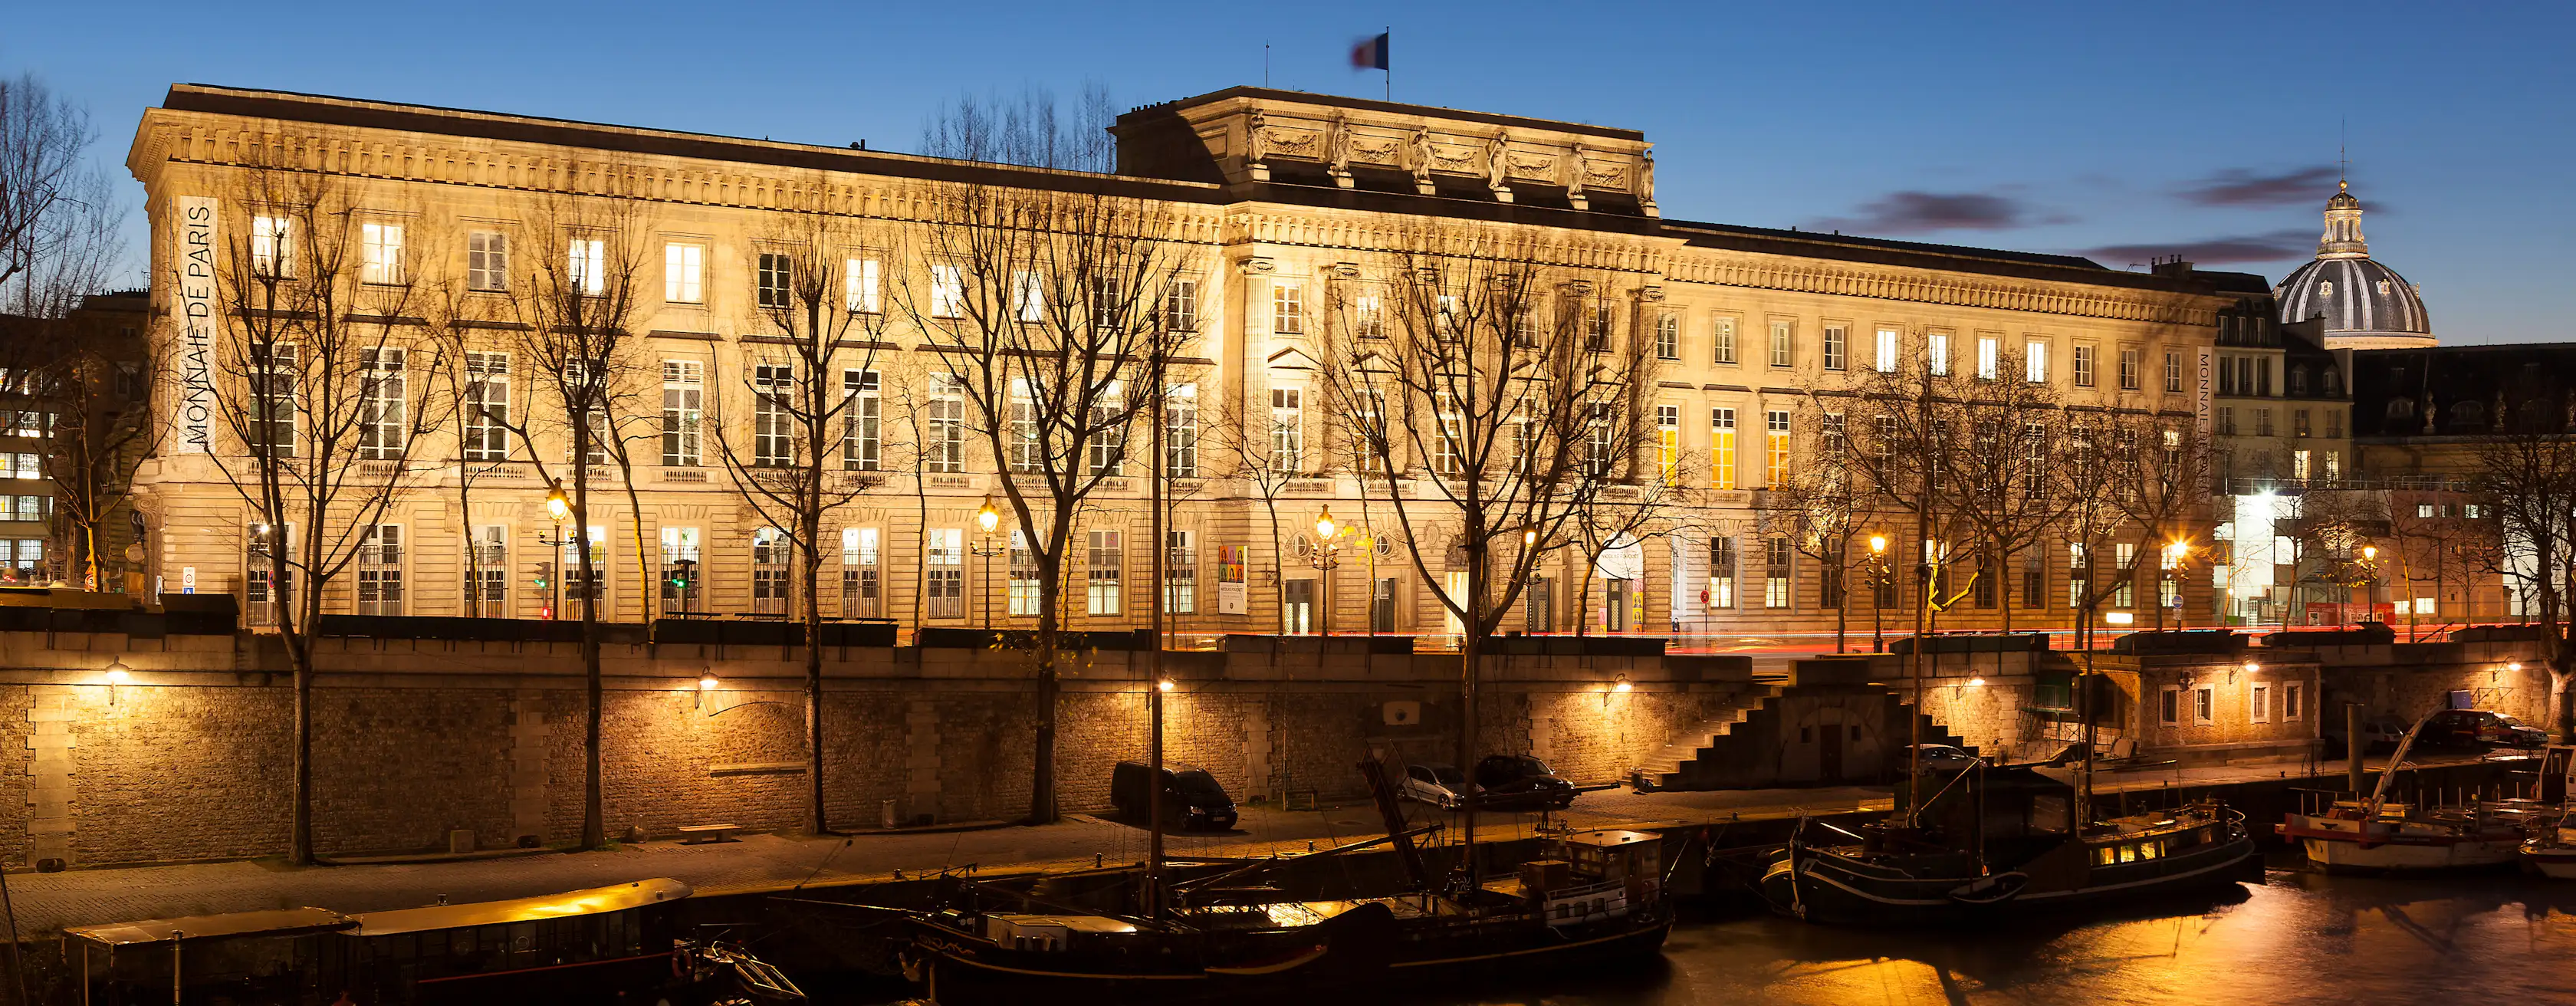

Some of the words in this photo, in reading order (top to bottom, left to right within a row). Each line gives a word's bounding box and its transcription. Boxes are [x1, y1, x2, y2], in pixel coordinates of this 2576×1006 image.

[188, 206, 209, 278] PARIS
[188, 286, 209, 317] DE
[187, 326, 208, 444] MONNAIE
[2199, 354, 2208, 426] MONNAIE
